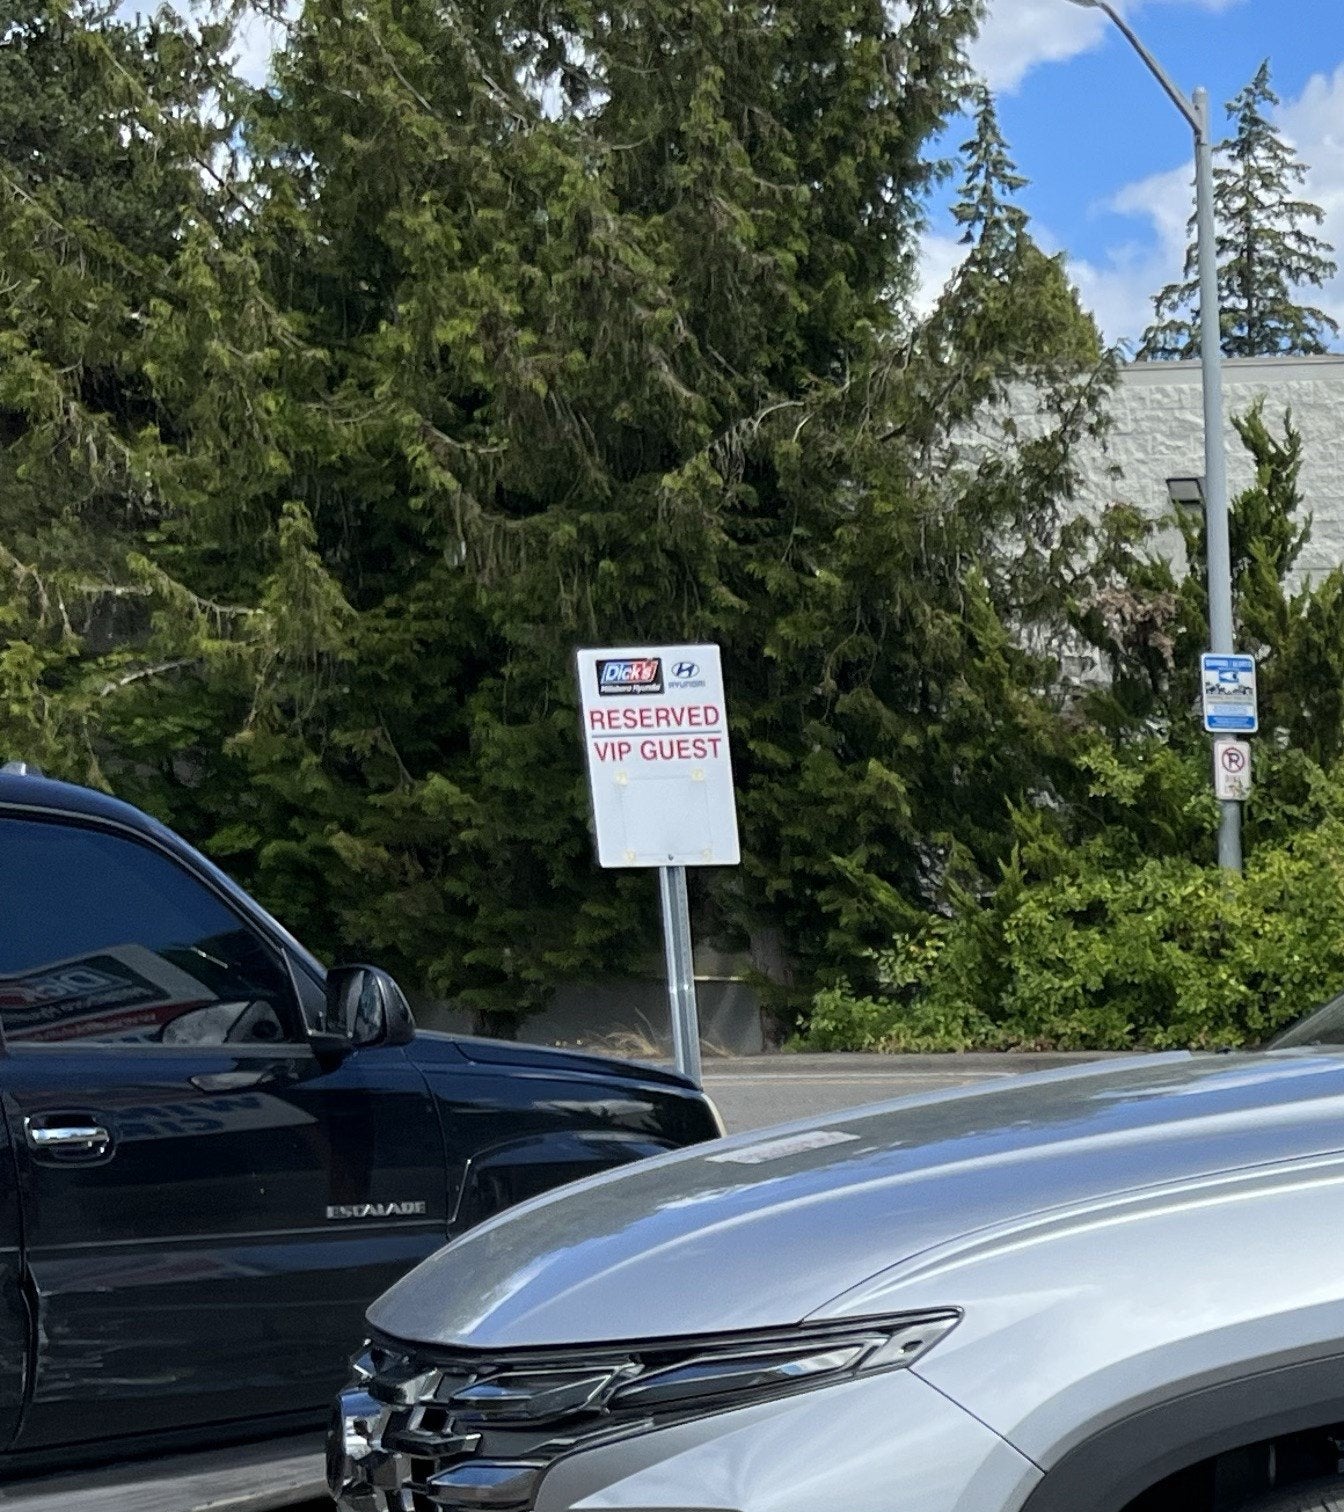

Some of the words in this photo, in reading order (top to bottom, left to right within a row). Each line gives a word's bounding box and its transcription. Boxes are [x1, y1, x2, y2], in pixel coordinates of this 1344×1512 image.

[589, 705, 720, 730] RESERVED
[593, 742, 631, 762] VIP
[640, 738, 722, 761] GUEST
[326, 1200, 426, 1219] ESCALADE
